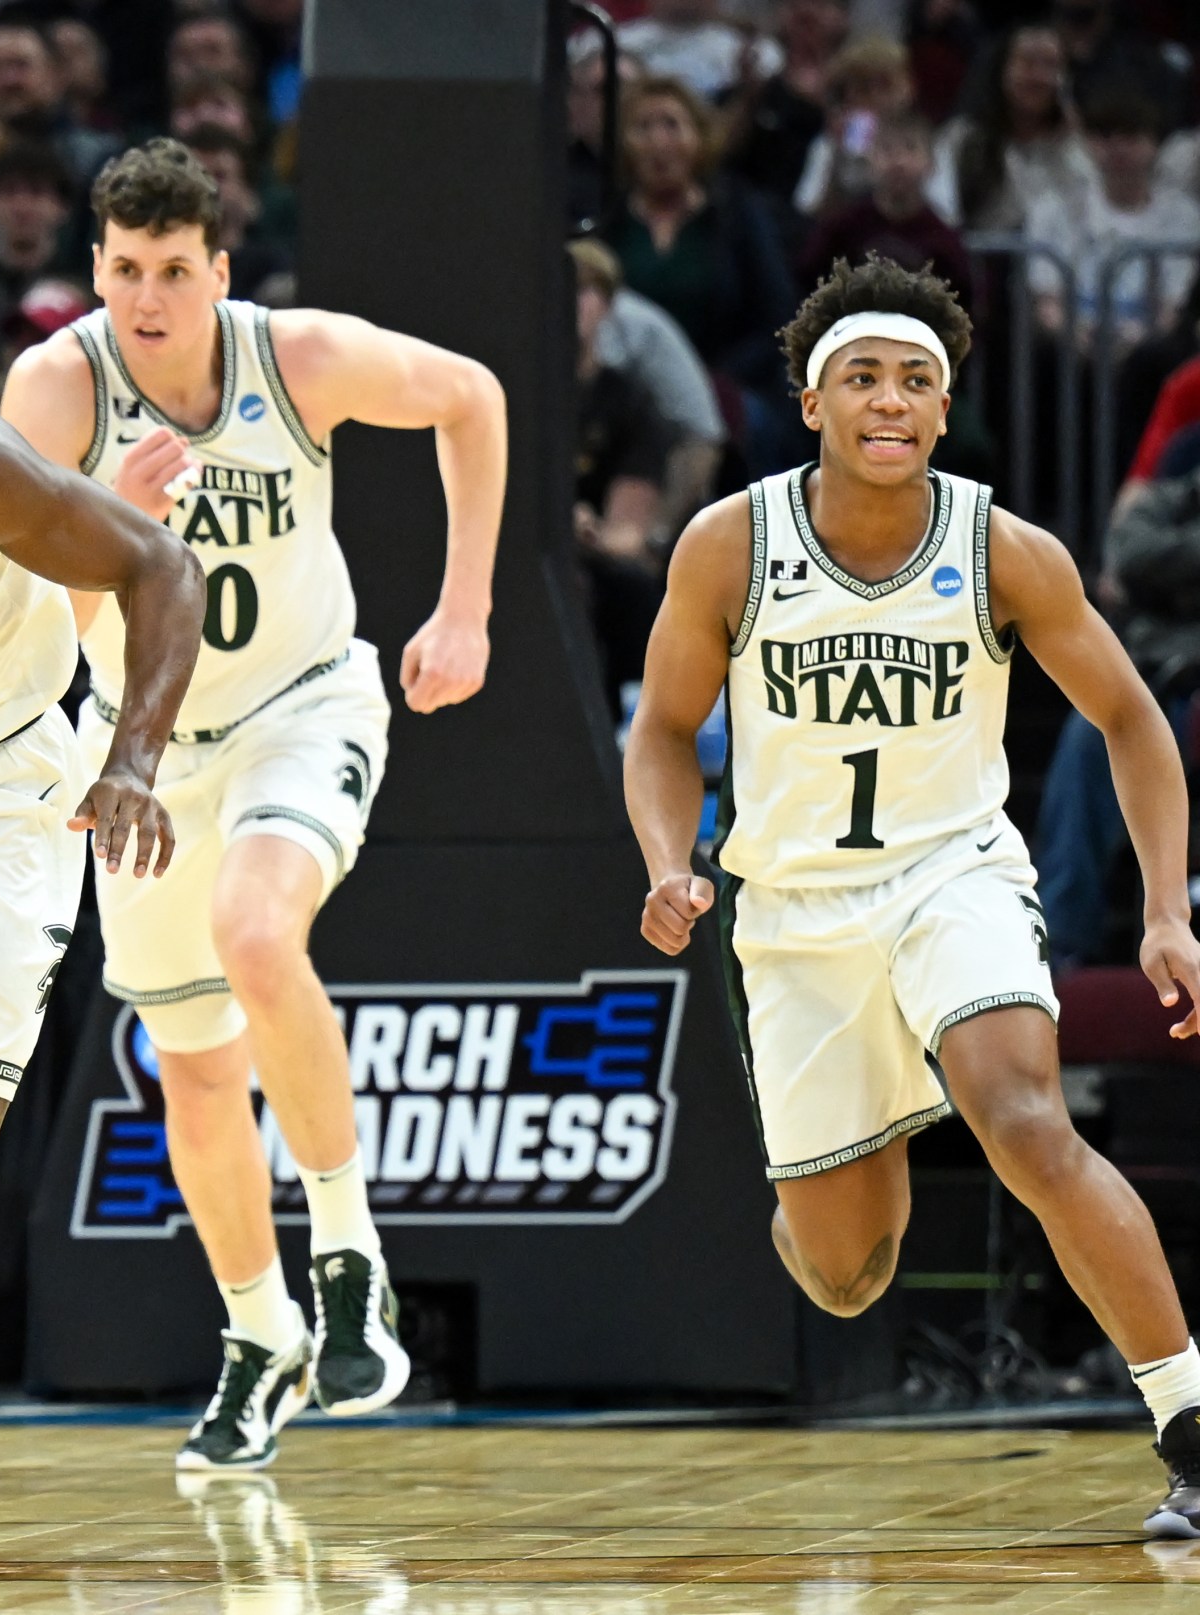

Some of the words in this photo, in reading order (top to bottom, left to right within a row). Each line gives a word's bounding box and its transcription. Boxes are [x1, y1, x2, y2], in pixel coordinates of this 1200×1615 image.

[163, 468, 296, 547] ATE
[204, 466, 260, 495] IGAN
[201, 562, 258, 652] 0
[777, 560, 801, 580] JF
[936, 578, 961, 591] NCAA
[760, 639, 969, 727] STATE
[802, 634, 927, 667] MICHIGAN
[836, 748, 884, 849] 1
[338, 1004, 519, 1092] RCH
